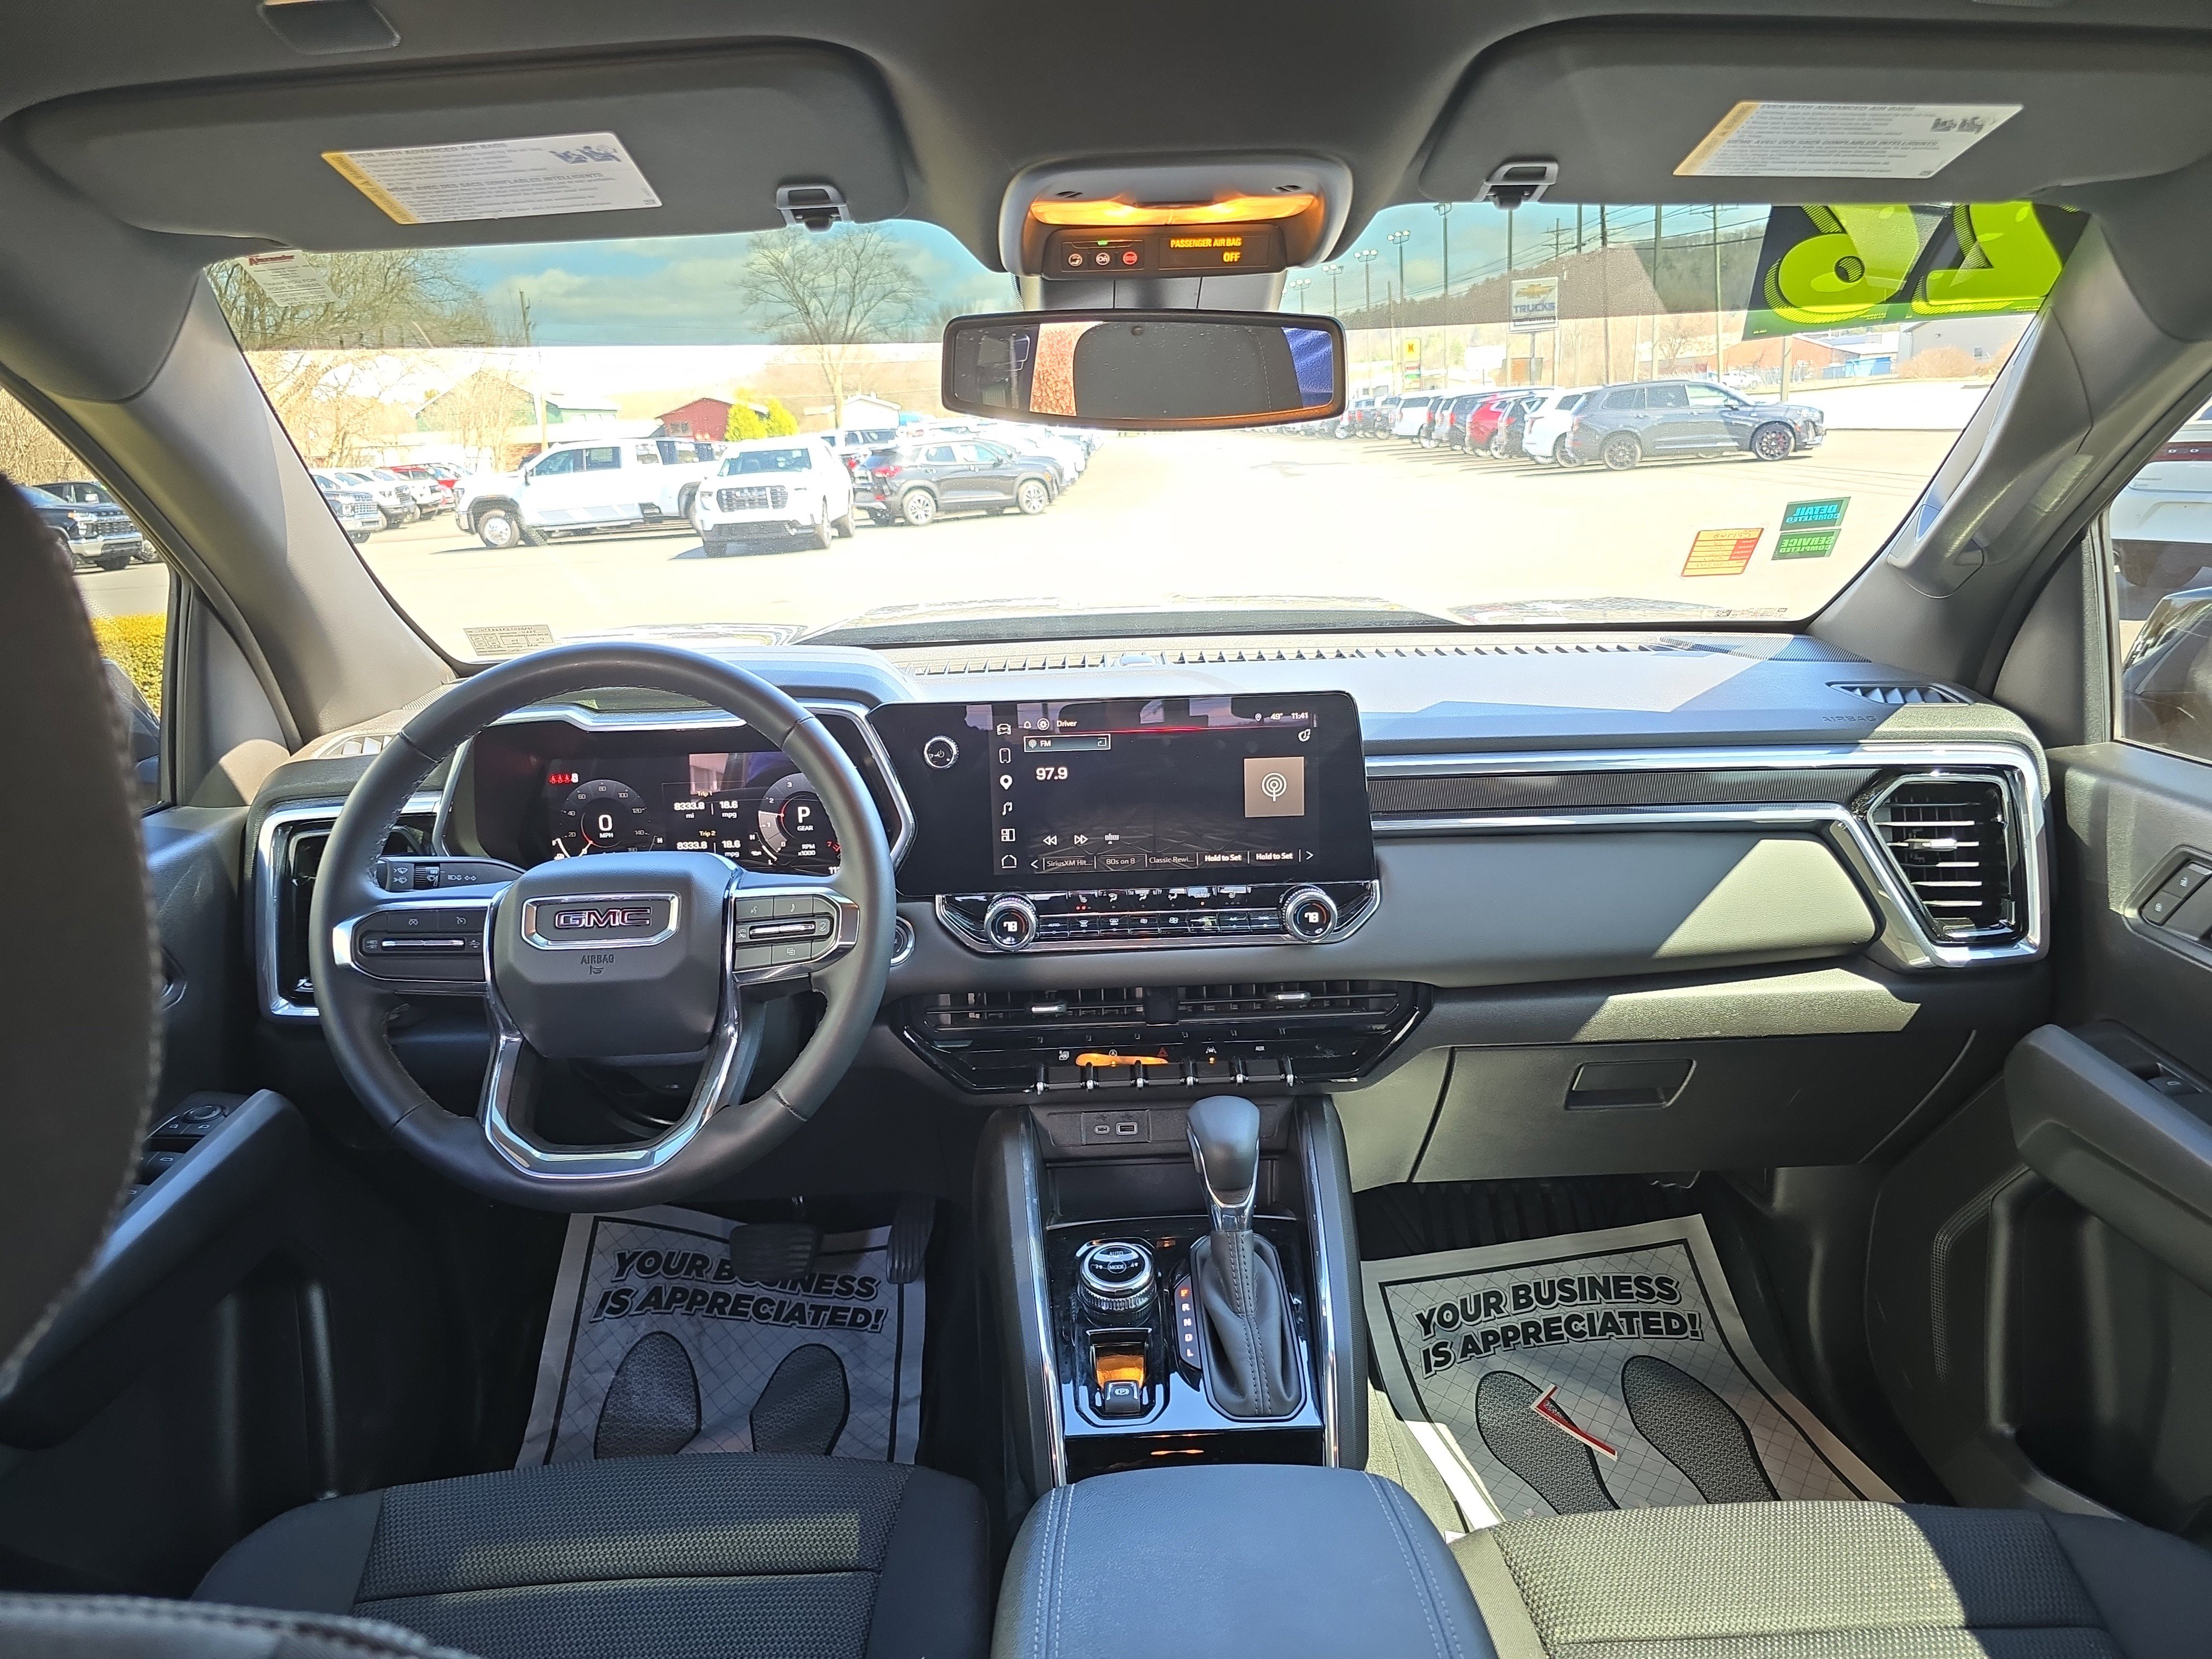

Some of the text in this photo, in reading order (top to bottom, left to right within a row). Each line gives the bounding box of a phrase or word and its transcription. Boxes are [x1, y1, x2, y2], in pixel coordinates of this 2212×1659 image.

[406, 146, 458, 156] ADVANCED
[486, 178, 541, 187] GONFLABLES
[542, 173, 604, 182] INTELLIGENTS
[1170, 237, 1242, 248] PASSENGER AIR BAG
[1223, 252, 1242, 263] OFF
[1513, 302, 1555, 313] TRUCKS
[1291, 711, 1309, 721] 11:41
[1056, 719, 1077, 729] Driver
[1040, 740, 1052, 748] FM
[1036, 766, 1068, 781] 97.9
[674, 800, 738, 811] 8333.8 18.6
[797, 806, 811, 824] P
[599, 814, 613, 831] 0
[677, 840, 741, 850] 8333.8 18.6
[555, 907, 651, 929] GMC
[580, 954, 614, 964] AIRBAG
[614, 1250, 879, 1299] YOUR BNESS
[1180, 1289, 1189, 1297] P
[593, 1288, 887, 1332] IS APPRECIATED!
[1182, 1302, 1191, 1311] R
[1414, 1274, 1681, 1338] YOUR BUSINESS
[1184, 1318, 1192, 1327] N
[1185, 1333, 1193, 1342] D
[1420, 1310, 1703, 1377] IS APPRECIATED!
[1186, 1349, 1194, 1357] L
